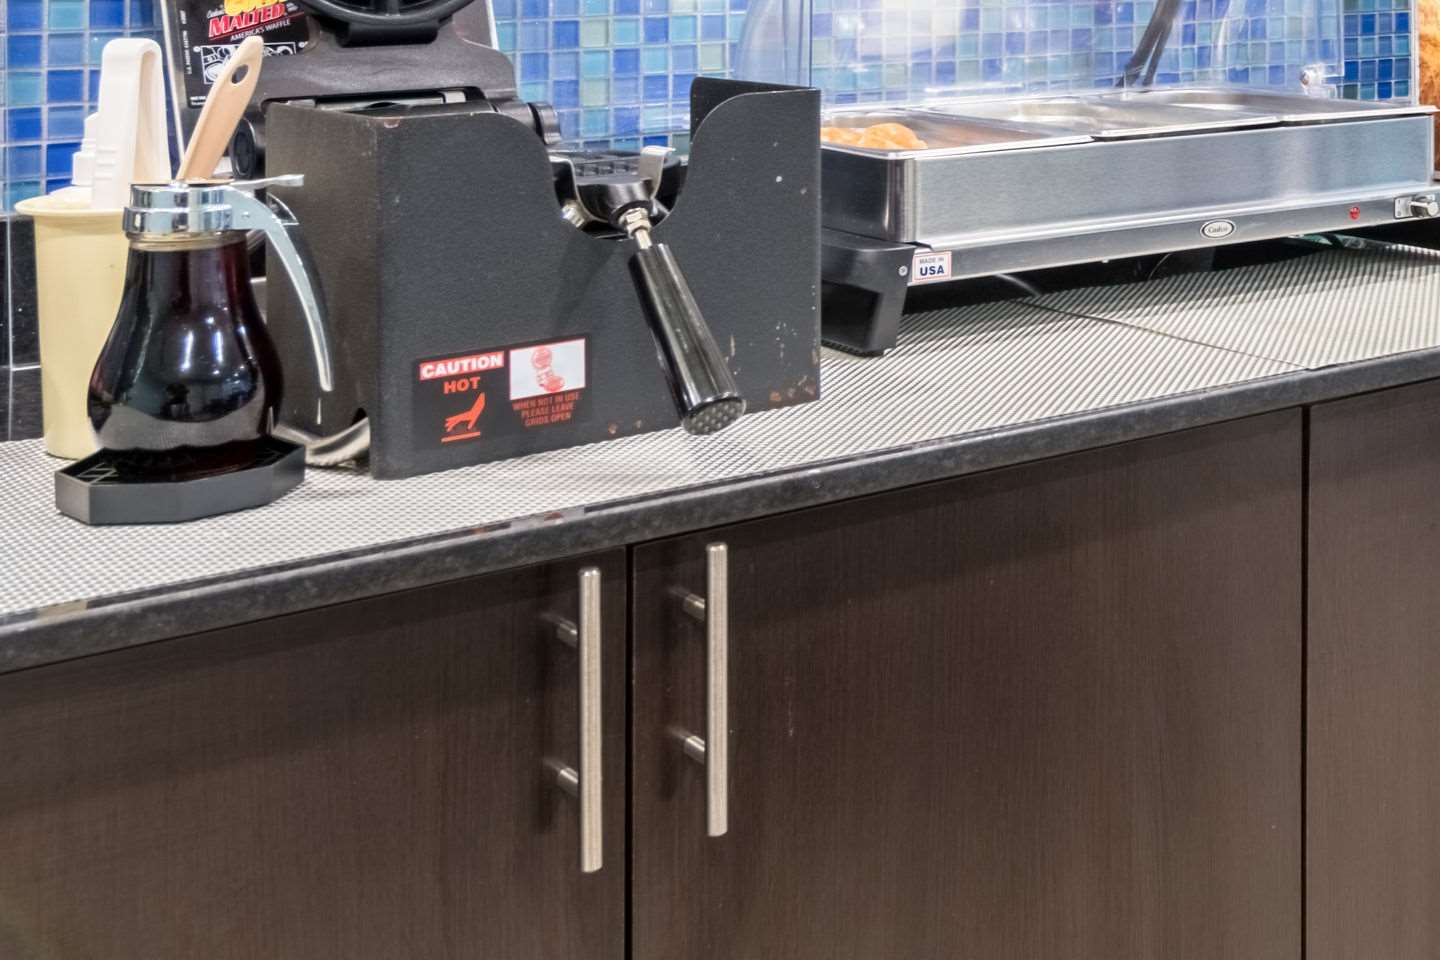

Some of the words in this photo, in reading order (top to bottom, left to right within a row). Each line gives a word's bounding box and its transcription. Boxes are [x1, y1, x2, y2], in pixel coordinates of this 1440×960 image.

[208, 3, 286, 38] MALTED
[265, 18, 290, 34] WAFFLE
[919, 265, 945, 276] USA
[421, 354, 503, 379] CAUTION
[443, 376, 481, 394] HOT
